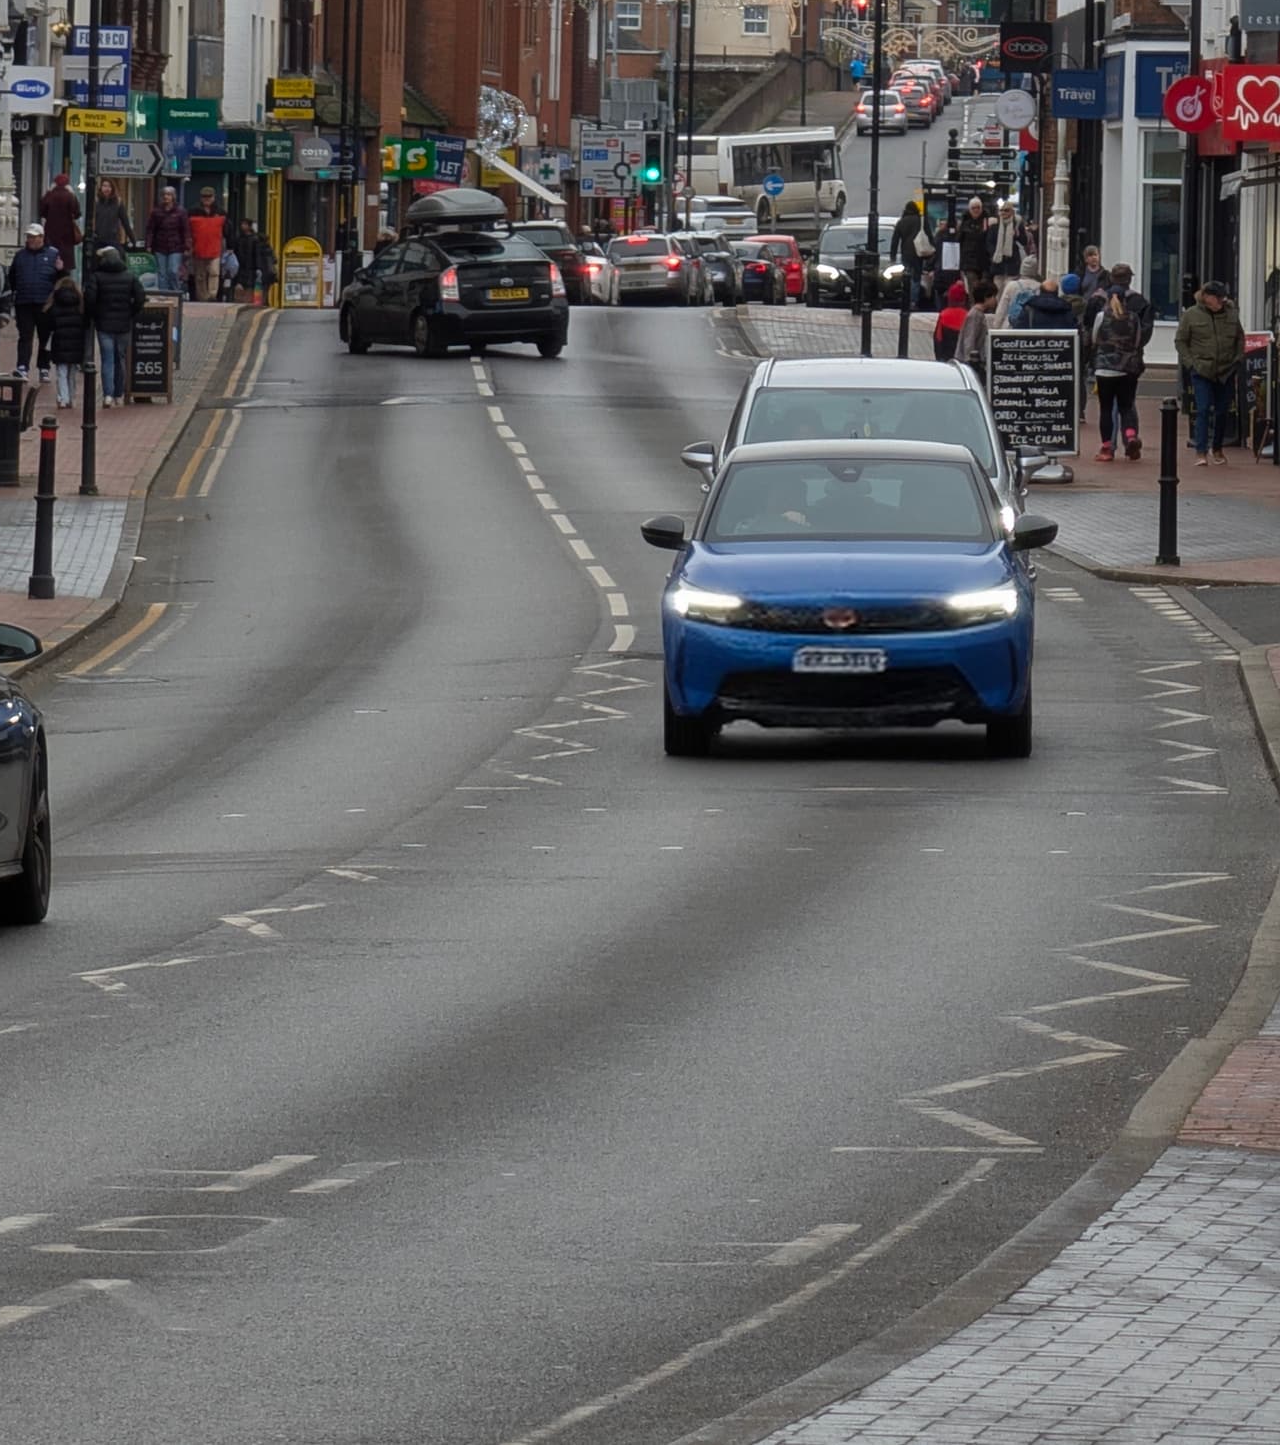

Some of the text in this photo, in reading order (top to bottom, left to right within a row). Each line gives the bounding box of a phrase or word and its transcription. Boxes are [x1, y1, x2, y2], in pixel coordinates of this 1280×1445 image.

[1007, 40, 1048, 53] choice
[1057, 88, 1096, 101] Travel
[276, 99, 312, 107] PHOTOS
[85, 113, 107, 121] RIVER
[170, 109, 210, 118] Specsavers
[84, 121, 106, 129] WALK
[301, 148, 329, 156] COSTA
[440, 161, 461, 176] LET
[135, 362, 163, 374] £65
